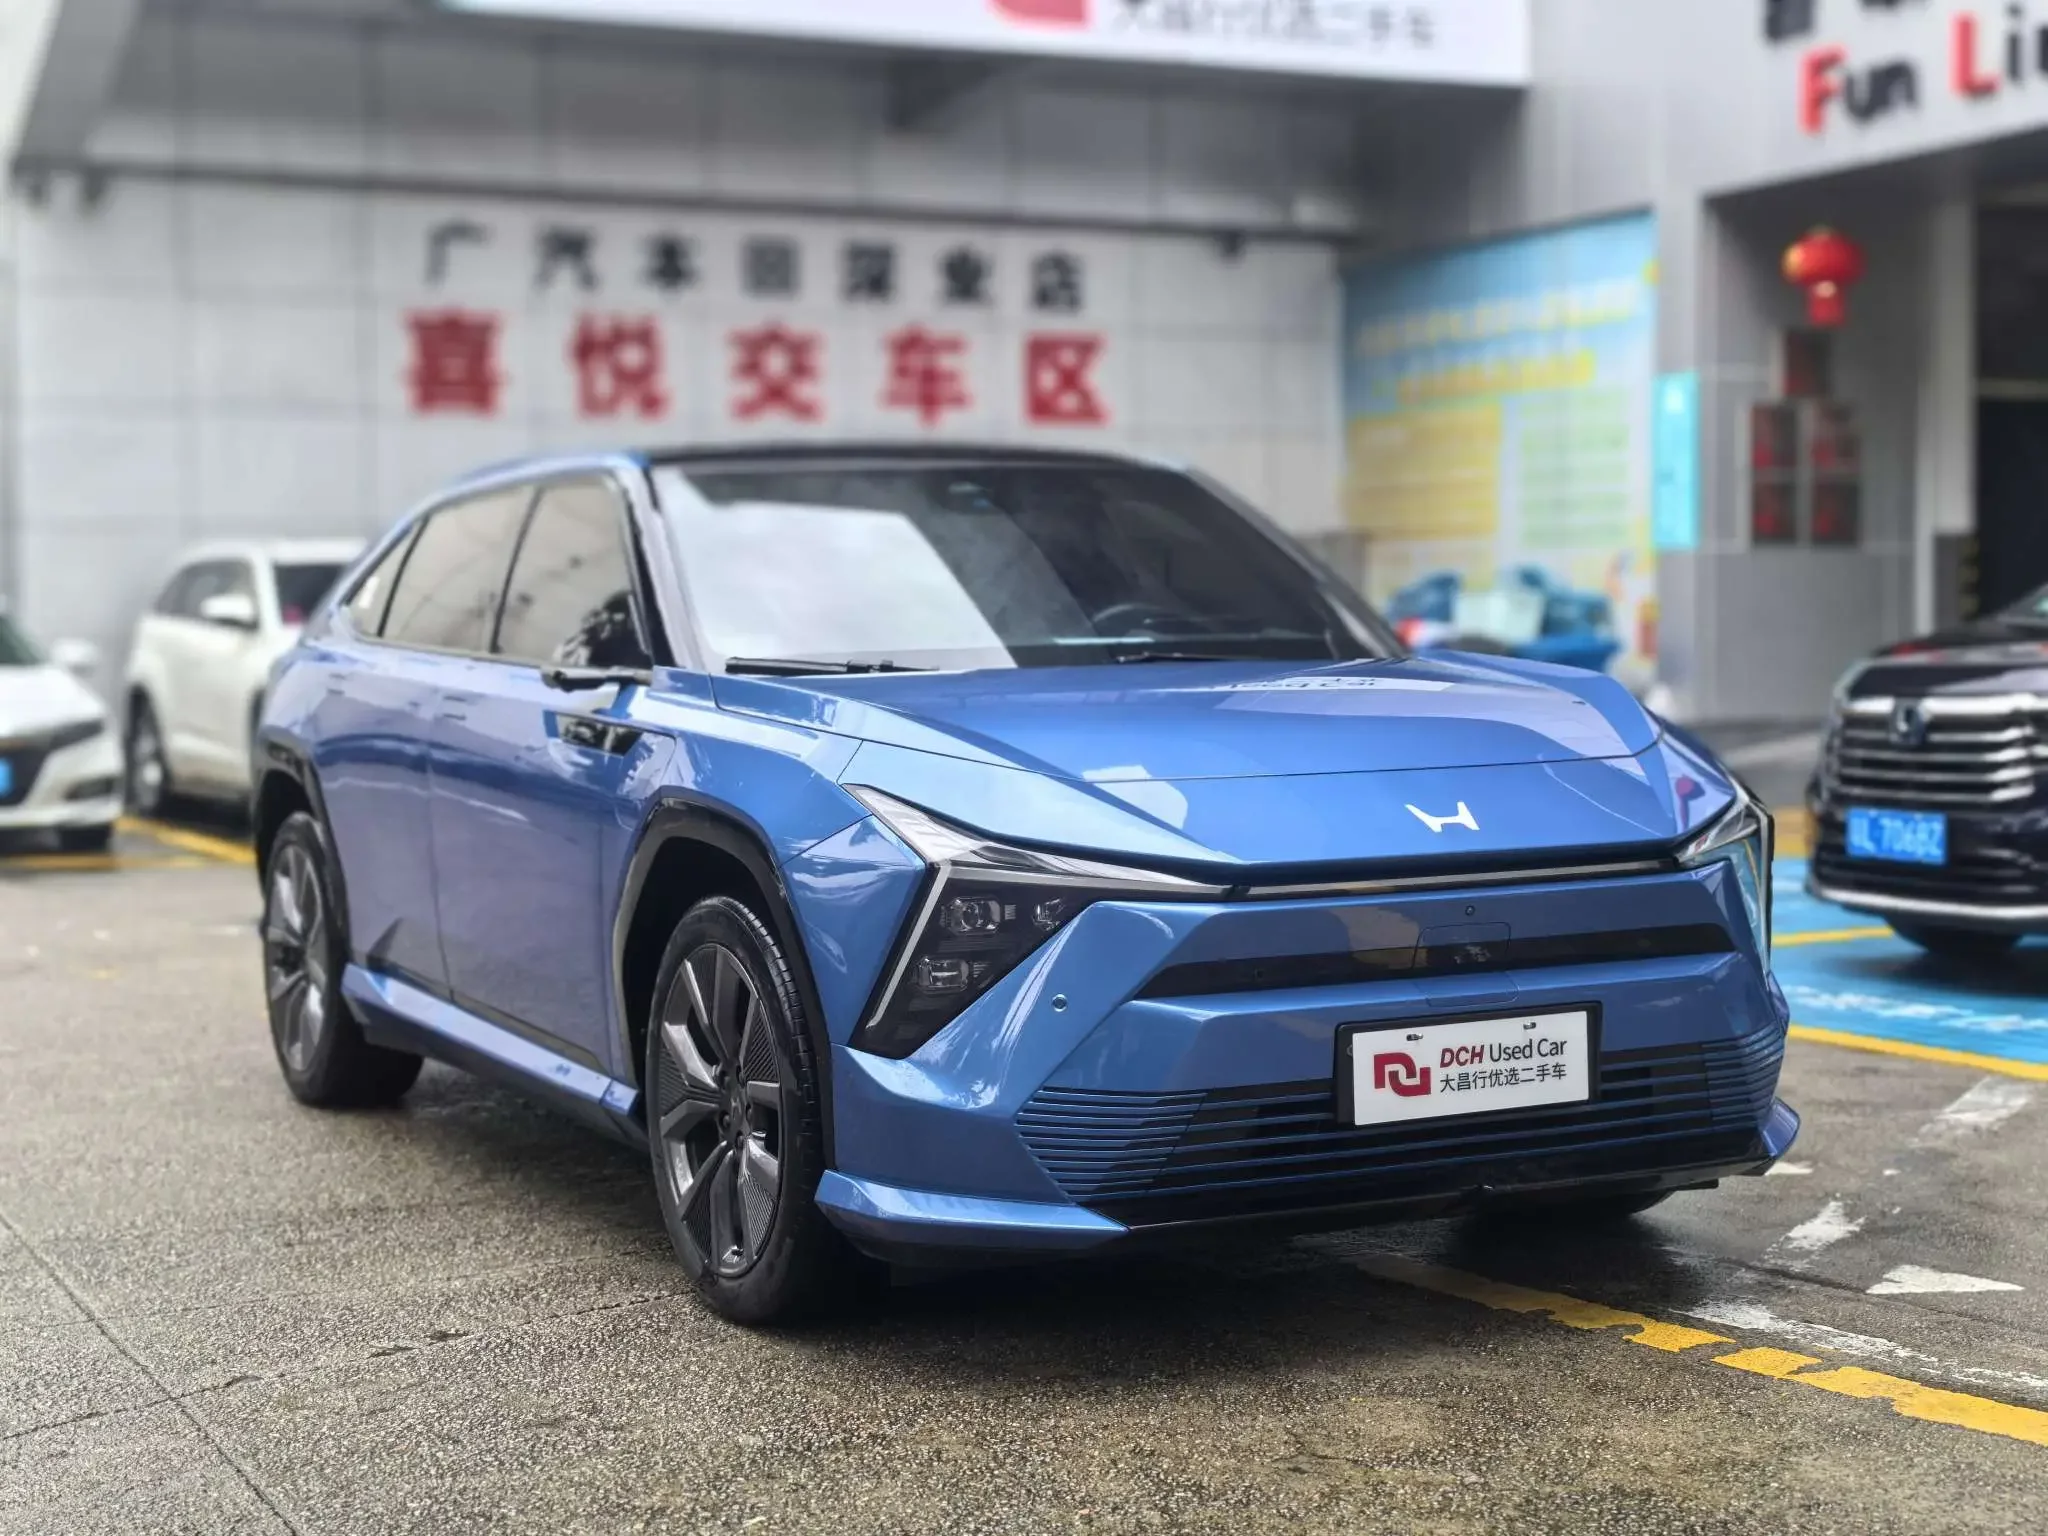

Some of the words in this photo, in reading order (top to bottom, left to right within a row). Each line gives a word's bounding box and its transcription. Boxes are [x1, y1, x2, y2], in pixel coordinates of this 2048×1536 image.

[1799, 42, 1919, 136] Fun
[404, 309, 1110, 427] 喜悦交车区
[1439, 1062, 1567, 1093] 大昌行优选二手车
[1440, 1044, 1484, 1068] DCH
[1489, 1039, 1533, 1062] Used
[1537, 1038, 1568, 1059] Car
